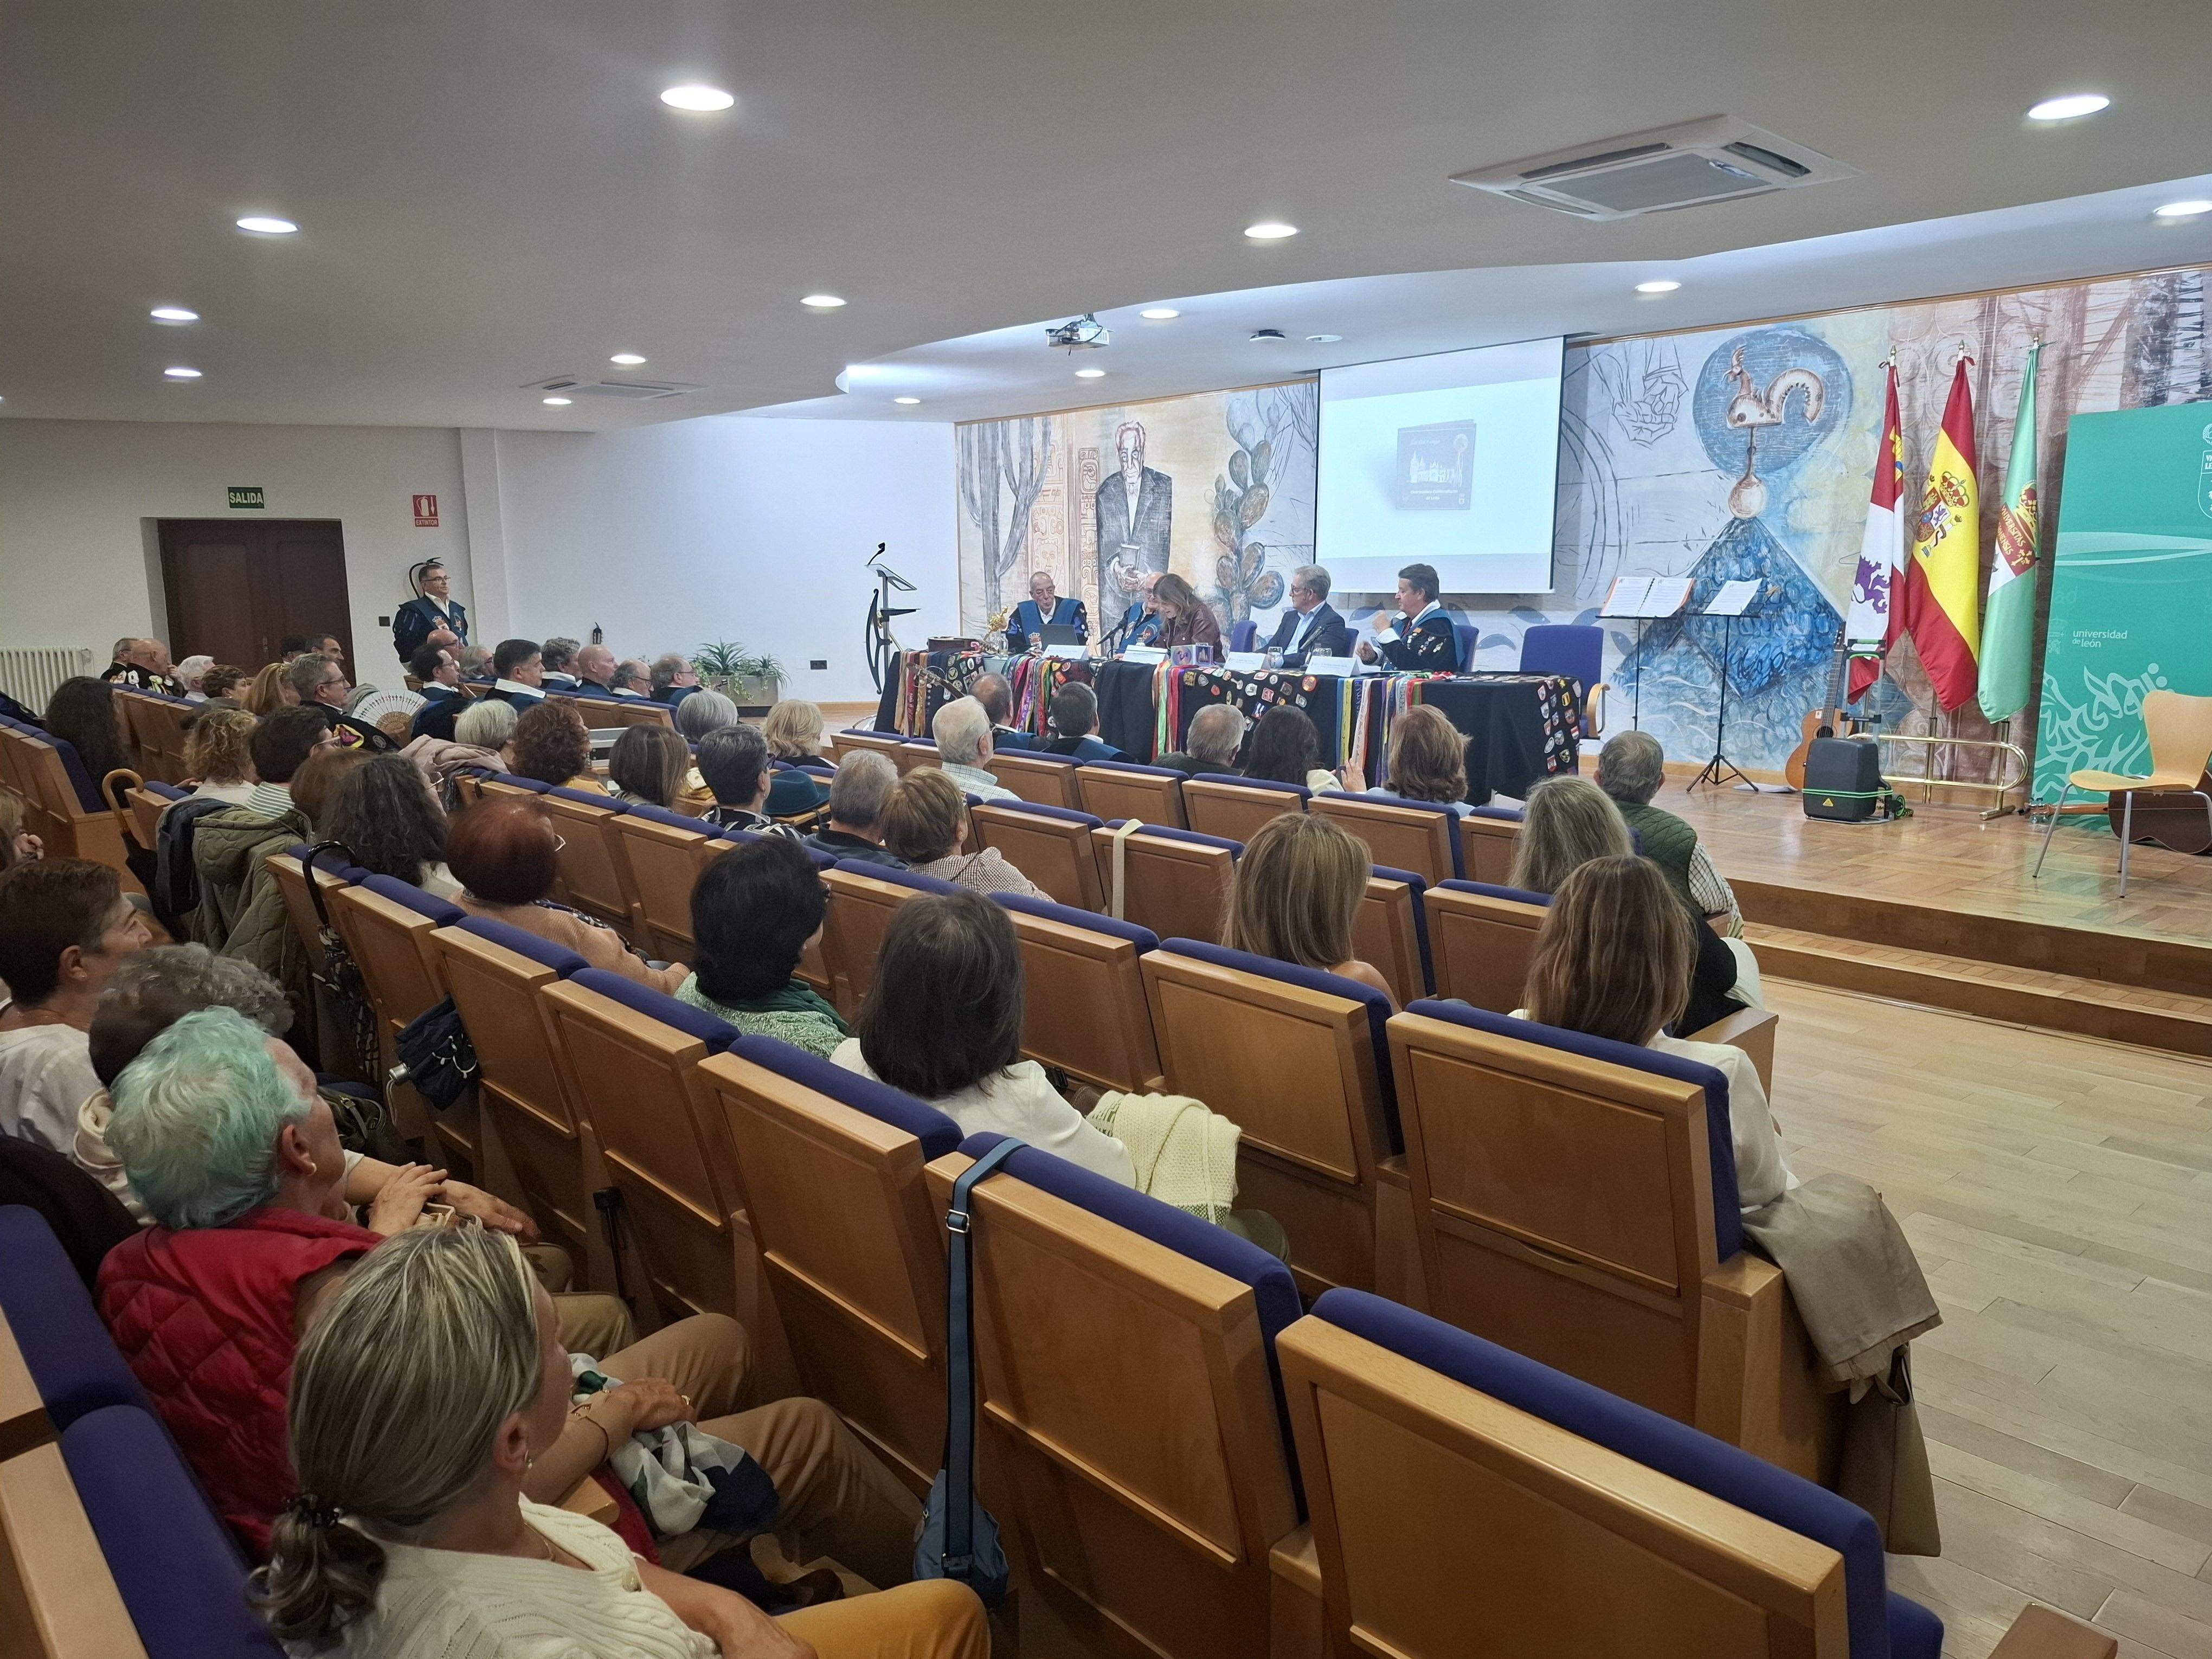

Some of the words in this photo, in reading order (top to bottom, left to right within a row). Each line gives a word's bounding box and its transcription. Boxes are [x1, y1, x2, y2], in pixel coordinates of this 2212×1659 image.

[229, 492, 263, 504] SALIDA
[2073, 629, 2128, 639] universidad
[2081, 638, 2101, 648] león
